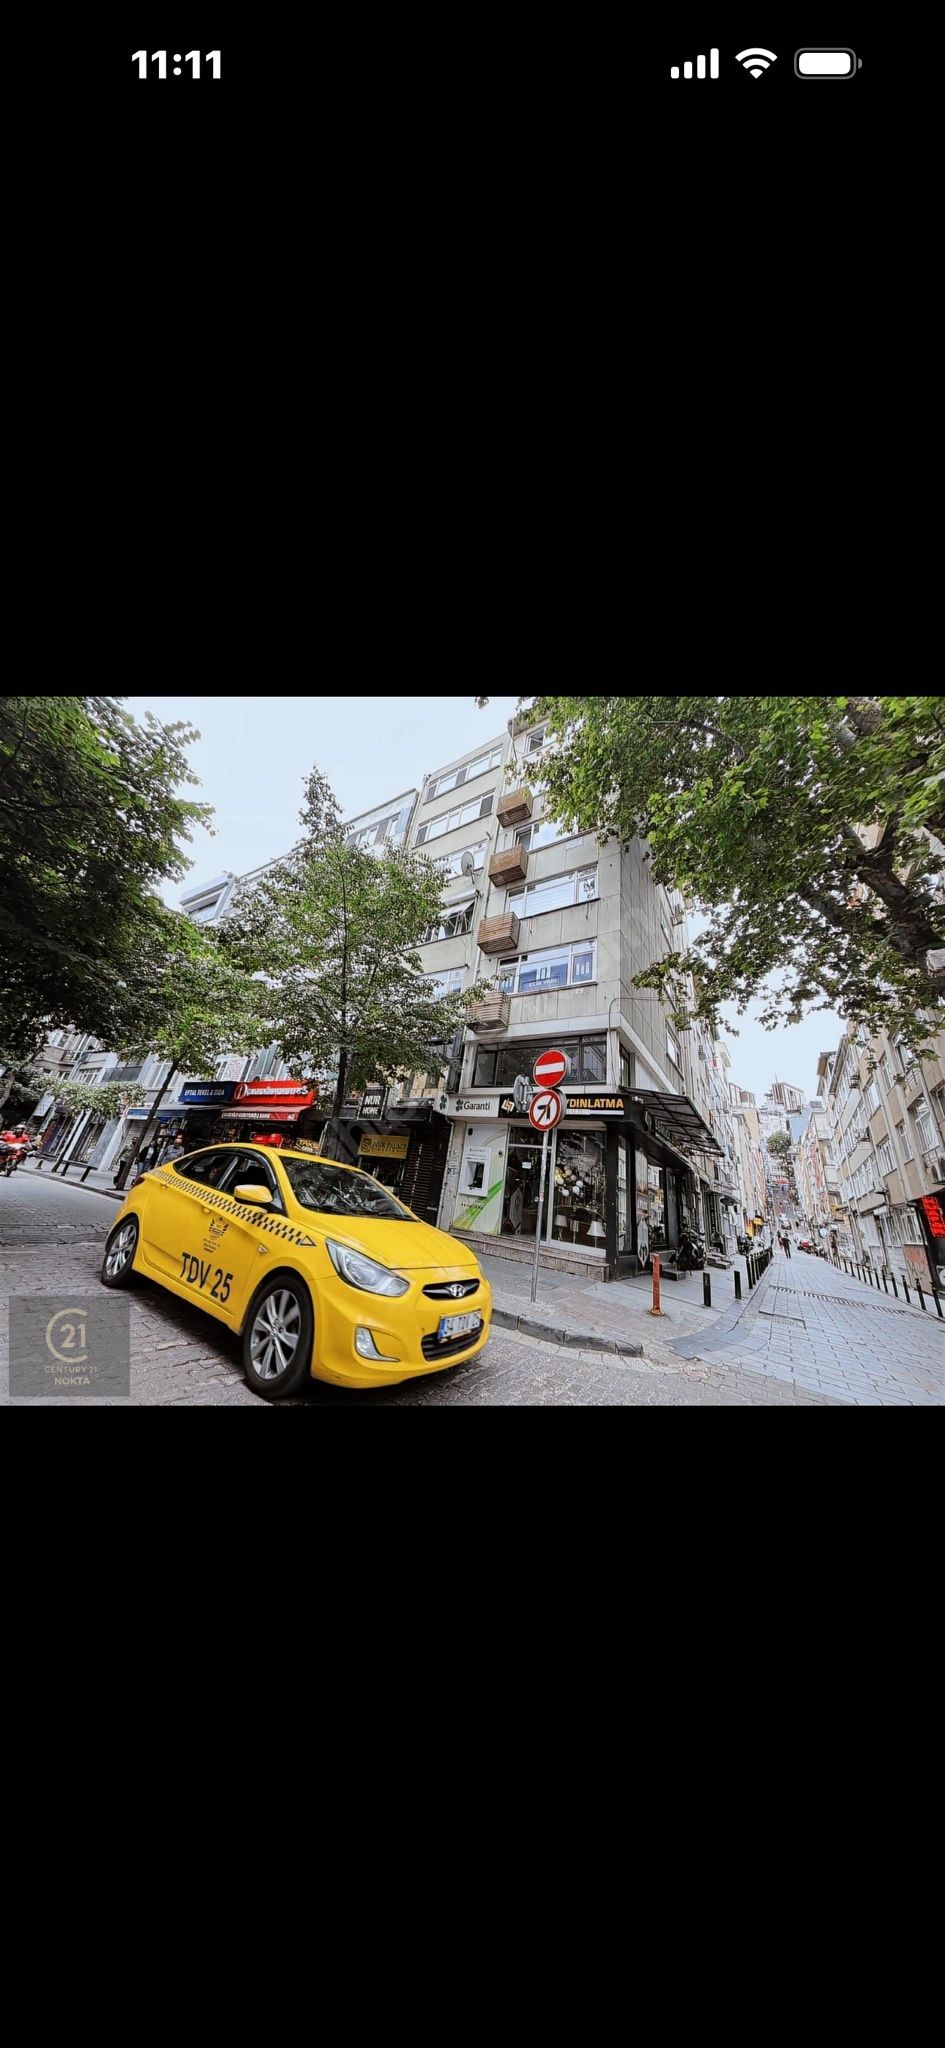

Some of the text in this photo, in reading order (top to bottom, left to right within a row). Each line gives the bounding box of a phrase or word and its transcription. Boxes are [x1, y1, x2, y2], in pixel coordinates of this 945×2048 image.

[364, 1095, 381, 1105] NUR
[362, 1106, 379, 1115] HOME
[463, 1100, 491, 1111] Garanti
[180, 1252, 234, 1303] TDV 25
